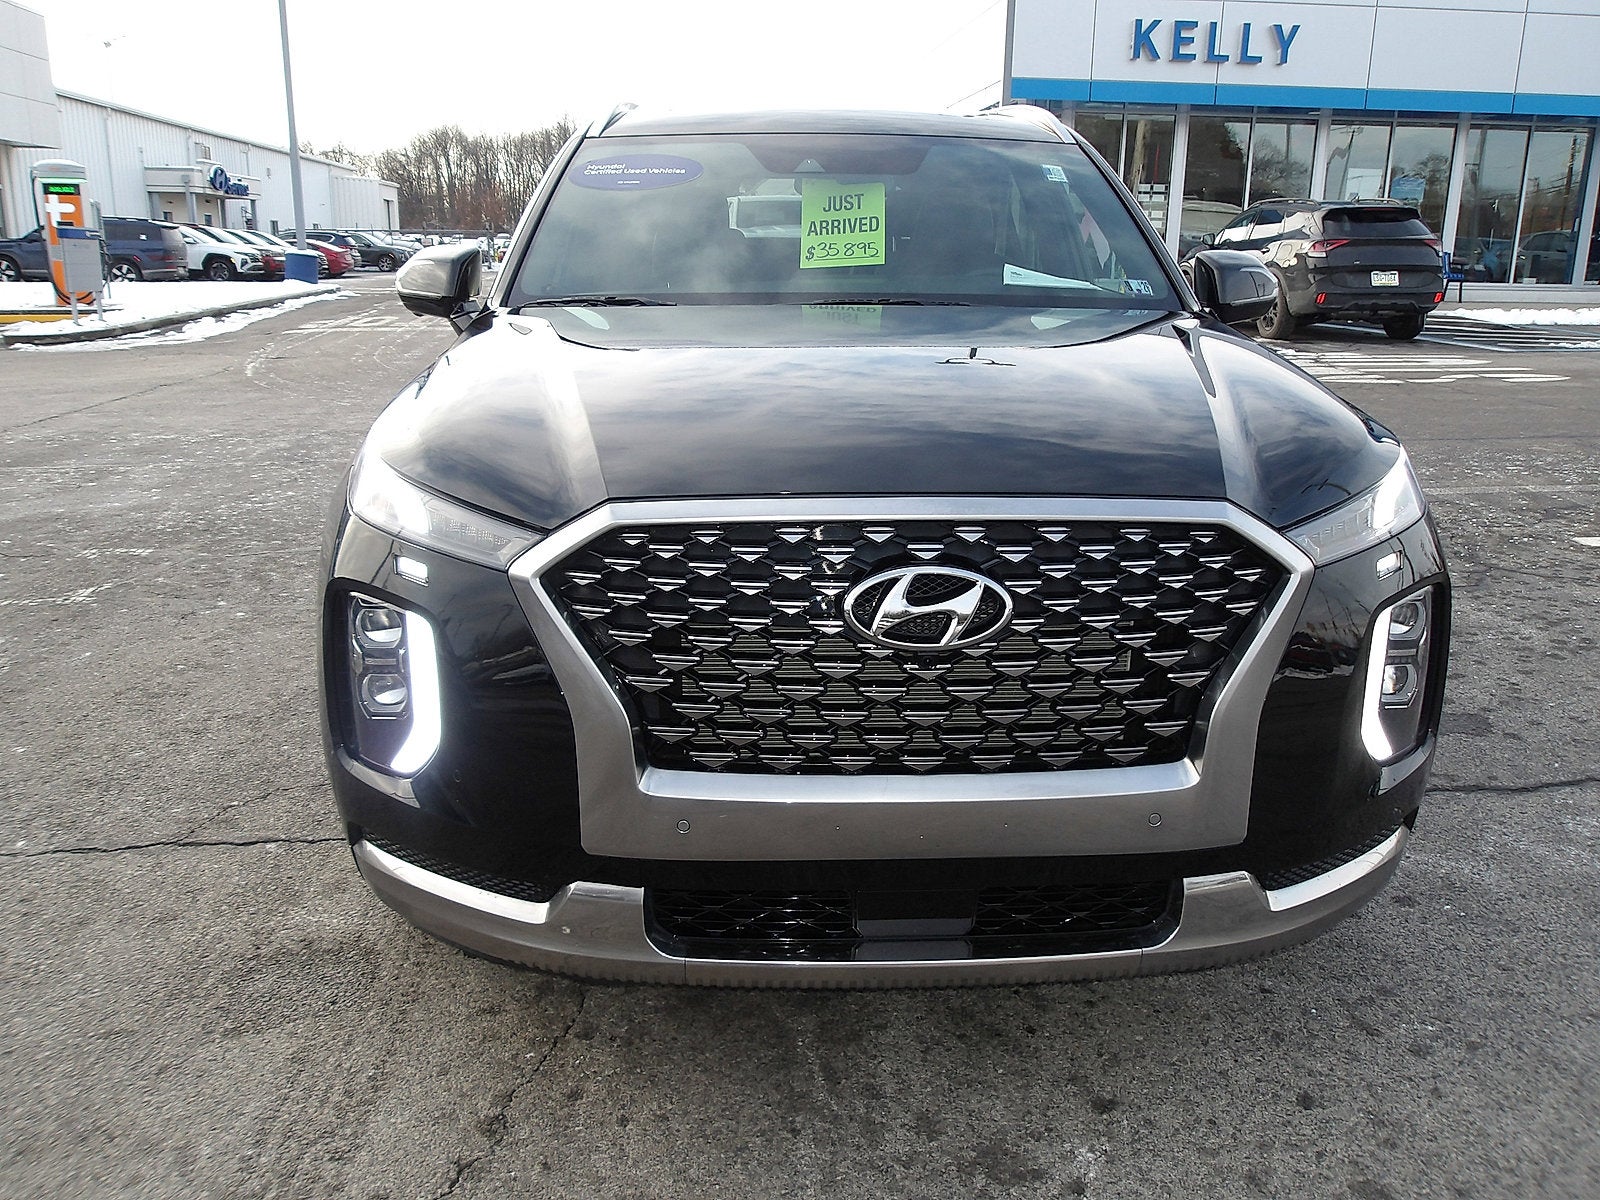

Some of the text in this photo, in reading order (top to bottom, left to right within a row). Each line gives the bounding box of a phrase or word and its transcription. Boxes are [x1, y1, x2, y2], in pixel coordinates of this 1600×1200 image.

[1130, 18, 1301, 65] KELLY
[823, 194, 864, 212] JUST
[806, 215, 880, 237] ARRIVED
